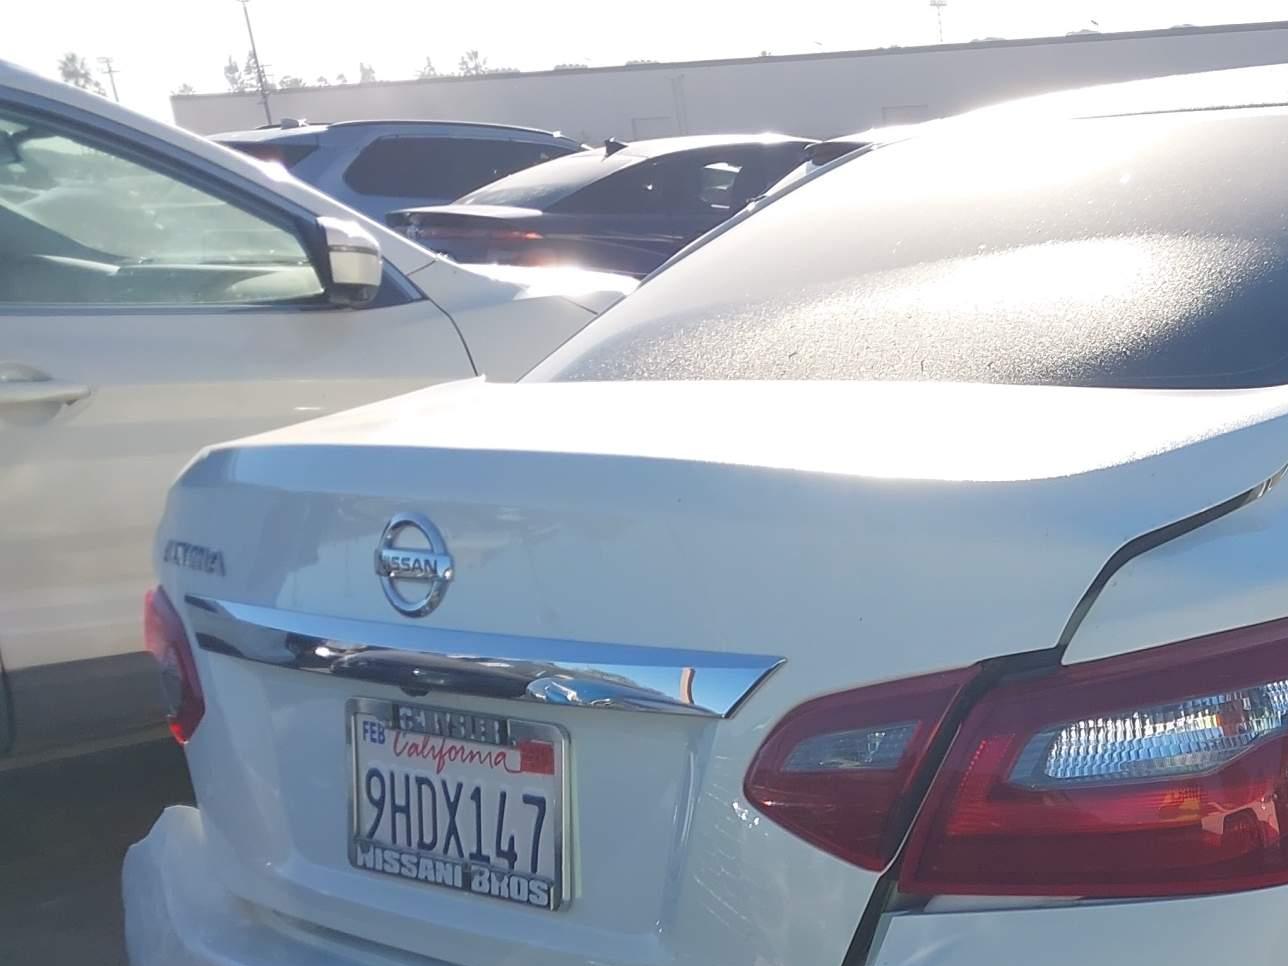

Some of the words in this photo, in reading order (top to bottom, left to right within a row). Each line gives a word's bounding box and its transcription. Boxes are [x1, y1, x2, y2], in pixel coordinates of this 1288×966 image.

[383, 555, 438, 574] NISSAN
[363, 720, 386, 744] FEB
[392, 730, 521, 774] California
[366, 767, 547, 874] 9HDX147
